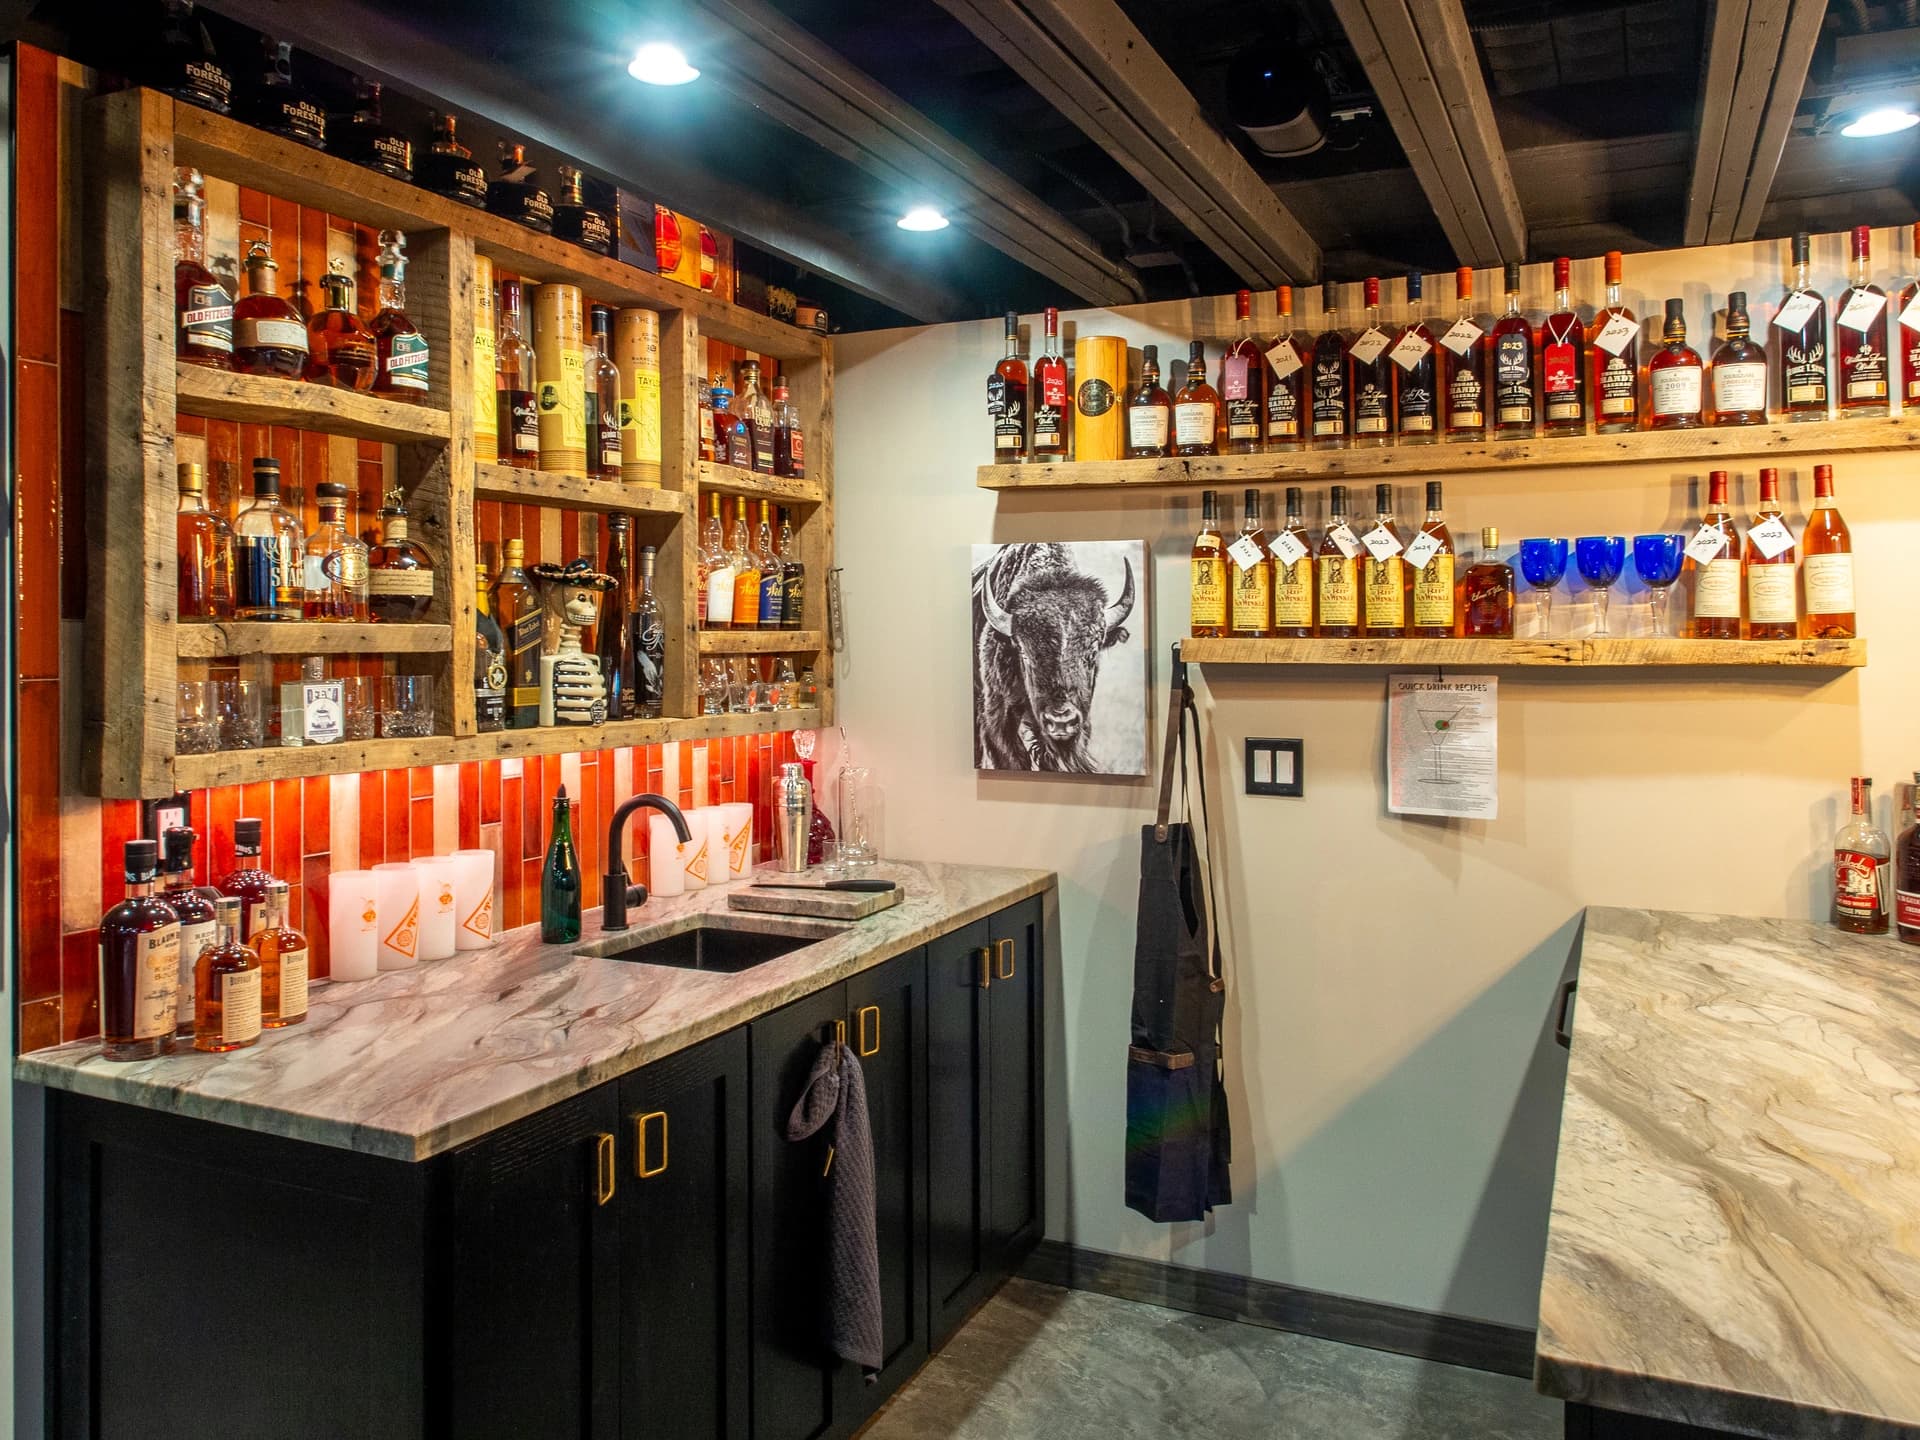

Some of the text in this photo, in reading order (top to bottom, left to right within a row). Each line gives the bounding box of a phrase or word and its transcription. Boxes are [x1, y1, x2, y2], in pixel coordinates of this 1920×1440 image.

[204, 62, 222, 76] OLD
[186, 64, 232, 90] FORESTER
[300, 101, 316, 113] OLD
[283, 104, 326, 127] FORESTER
[389, 137, 405, 149] OLD
[468, 168, 483, 179] OLD
[524, 197, 554, 213] FORESTER
[536, 194, 548, 204] OLD
[594, 217, 606, 226] OLD
[582, 221, 611, 236] FORESTER
[187, 312, 203, 323] OLD
[1398, 682, 1488, 692] QUICK DRINK RECIPES
